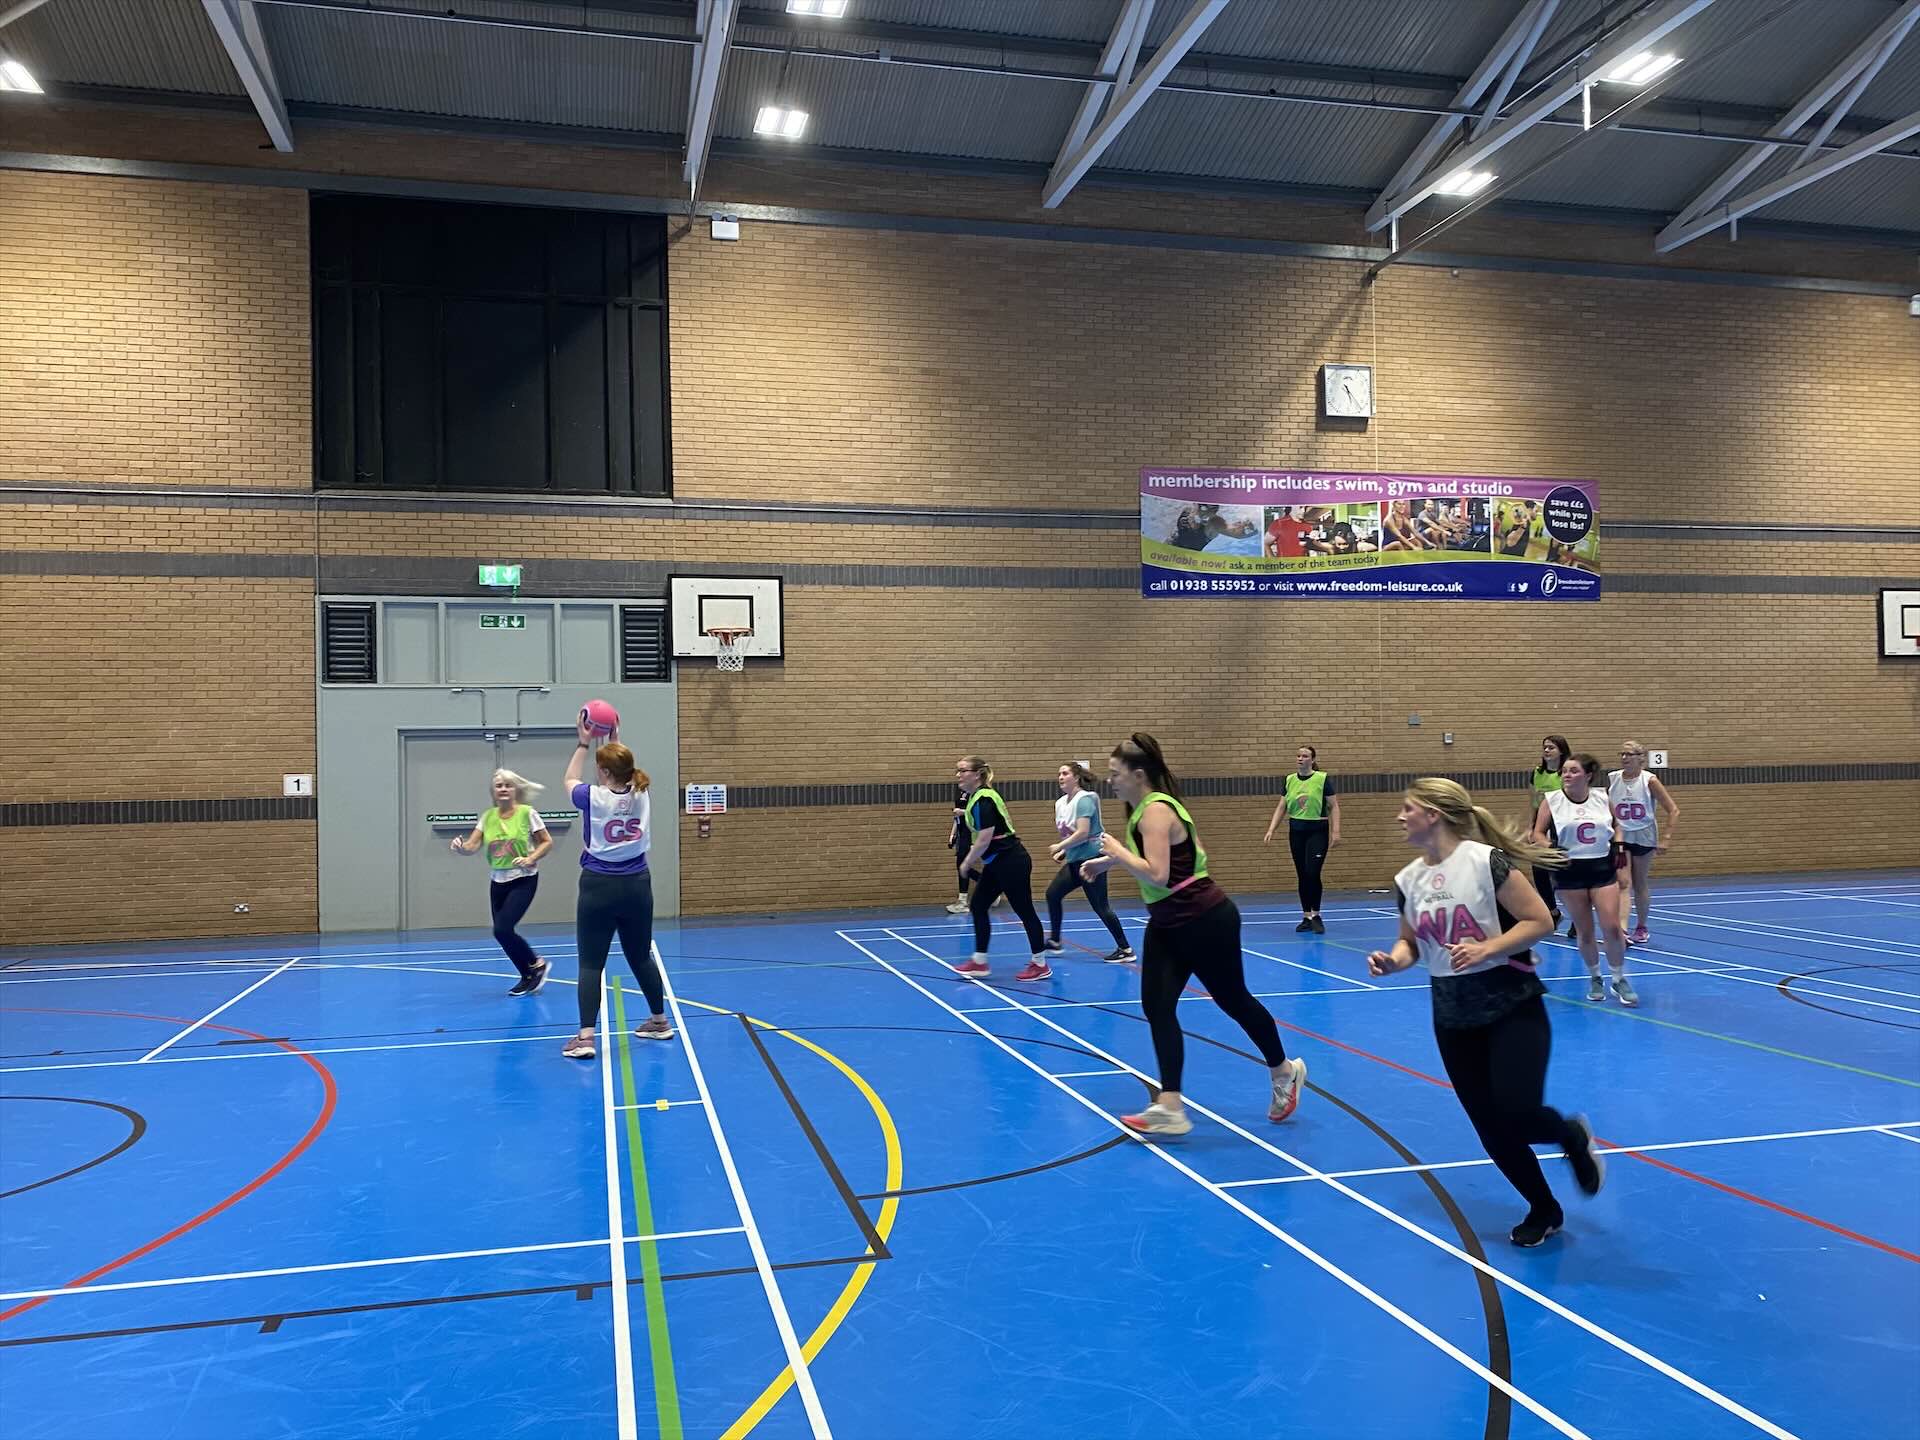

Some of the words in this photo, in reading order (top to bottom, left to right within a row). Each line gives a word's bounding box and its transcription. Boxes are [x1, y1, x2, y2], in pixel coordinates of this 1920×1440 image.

[1149, 474, 1257, 492] membership
[1262, 475, 1330, 491] includes
[1335, 477, 1384, 493] swim,
[1387, 481, 1423, 496] gym
[1427, 479, 1458, 494] and
[1462, 480, 1513, 496] studio
[1550, 499, 1569, 508] save
[1548, 509, 1571, 518] while
[1572, 512, 1588, 520] you
[1551, 519, 1569, 529] lose
[1569, 521, 1585, 530] lbs!
[1150, 551, 1198, 567] available
[1201, 559, 1227, 570] now!
[1229, 560, 1245, 570] ask
[1255, 559, 1294, 571] member
[1297, 559, 1308, 570] of
[1309, 558, 1326, 569] the
[1327, 556, 1351, 568] team
[1353, 554, 1379, 567] today
[1150, 580, 1168, 591] call
[1170, 580, 1208, 591] 01938
[1211, 580, 1256, 591] 555952
[1258, 583, 1271, 591] or
[1273, 581, 1294, 591] visit
[1297, 579, 1463, 593] www.freedom-leisure.co.uk
[1655, 754, 1663, 765] 3
[293, 778, 300, 792] 1
[1615, 803, 1647, 821] GD
[603, 817, 643, 844] GS
[1576, 822, 1597, 845] C
